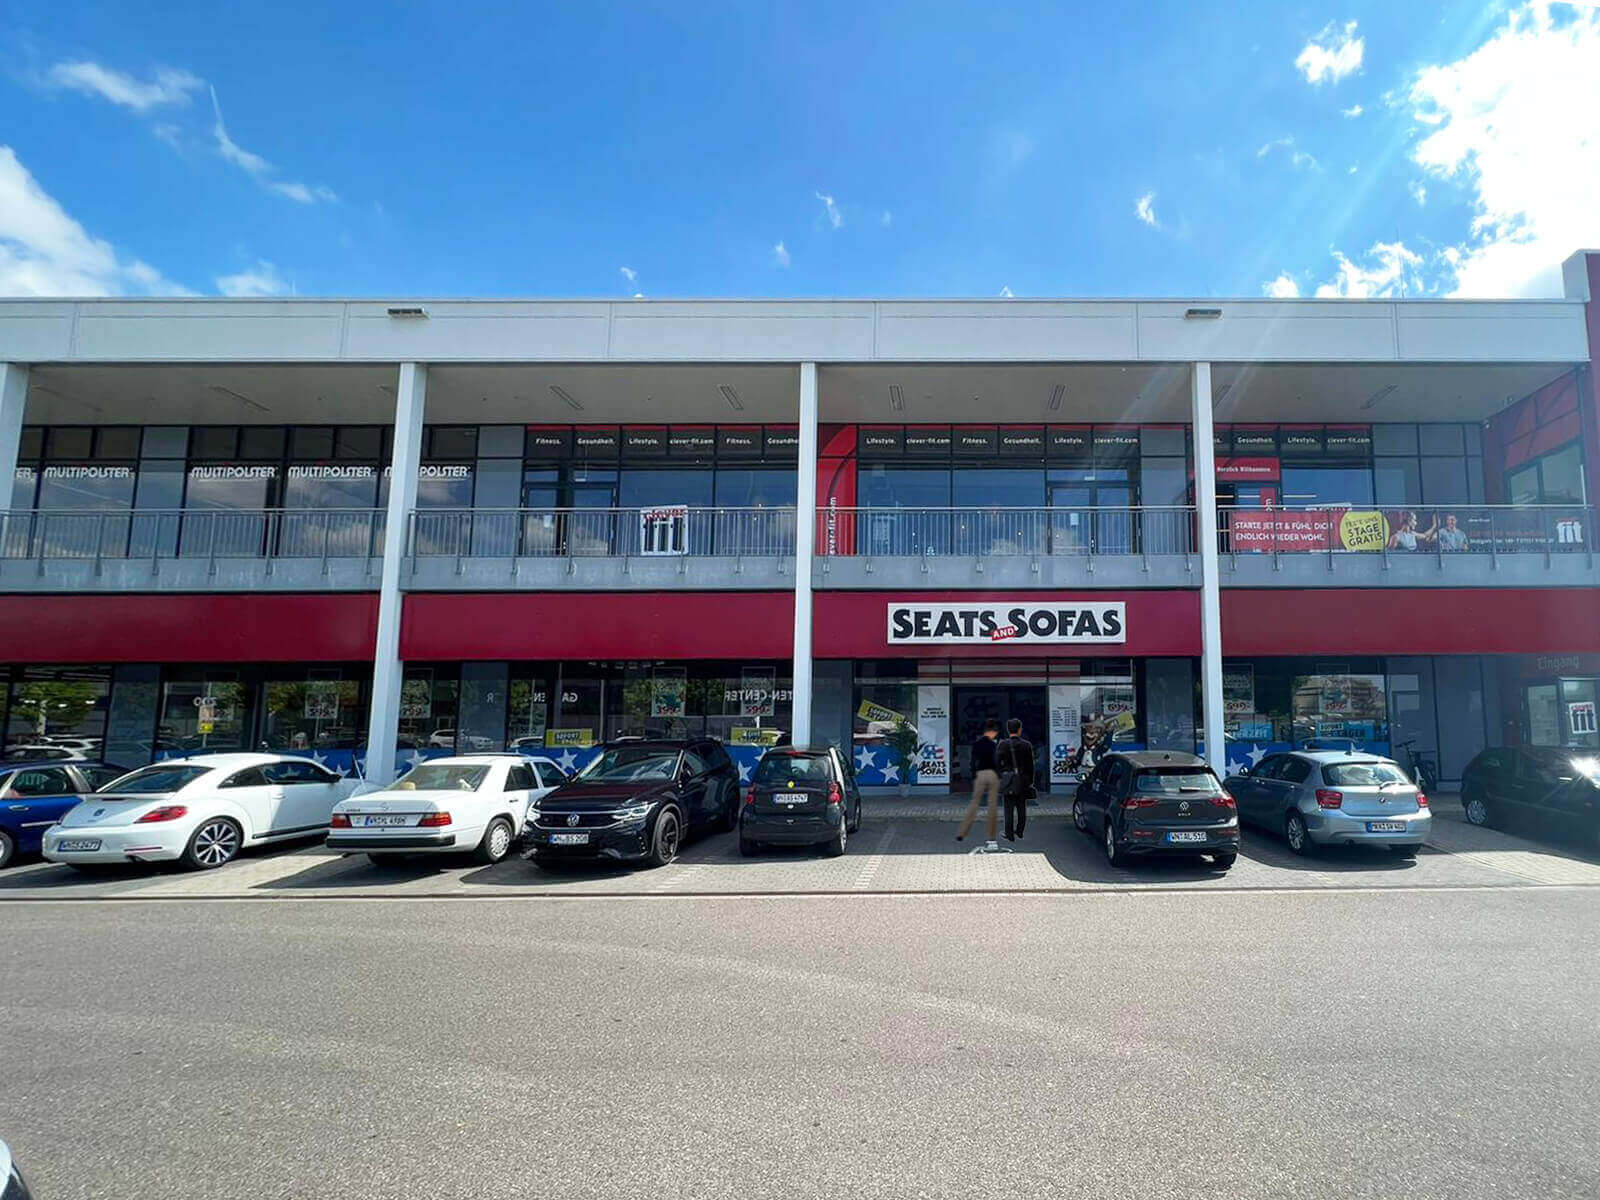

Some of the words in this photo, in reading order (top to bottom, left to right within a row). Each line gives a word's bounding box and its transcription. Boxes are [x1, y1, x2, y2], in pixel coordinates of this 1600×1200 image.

[766, 437, 799, 445] Gesundhe
[44, 466, 130, 479] MULTIPOLSTER
[191, 466, 277, 479] MULTIPOLSTER
[287, 466, 373, 479] MULTIPOLSTER
[1234, 522, 1262, 530] STARTE
[1348, 531, 1383, 546] GRATIS
[892, 608, 996, 639] SEATS
[992, 627, 1015, 639] AND
[1007, 608, 1122, 638] SOFAS
